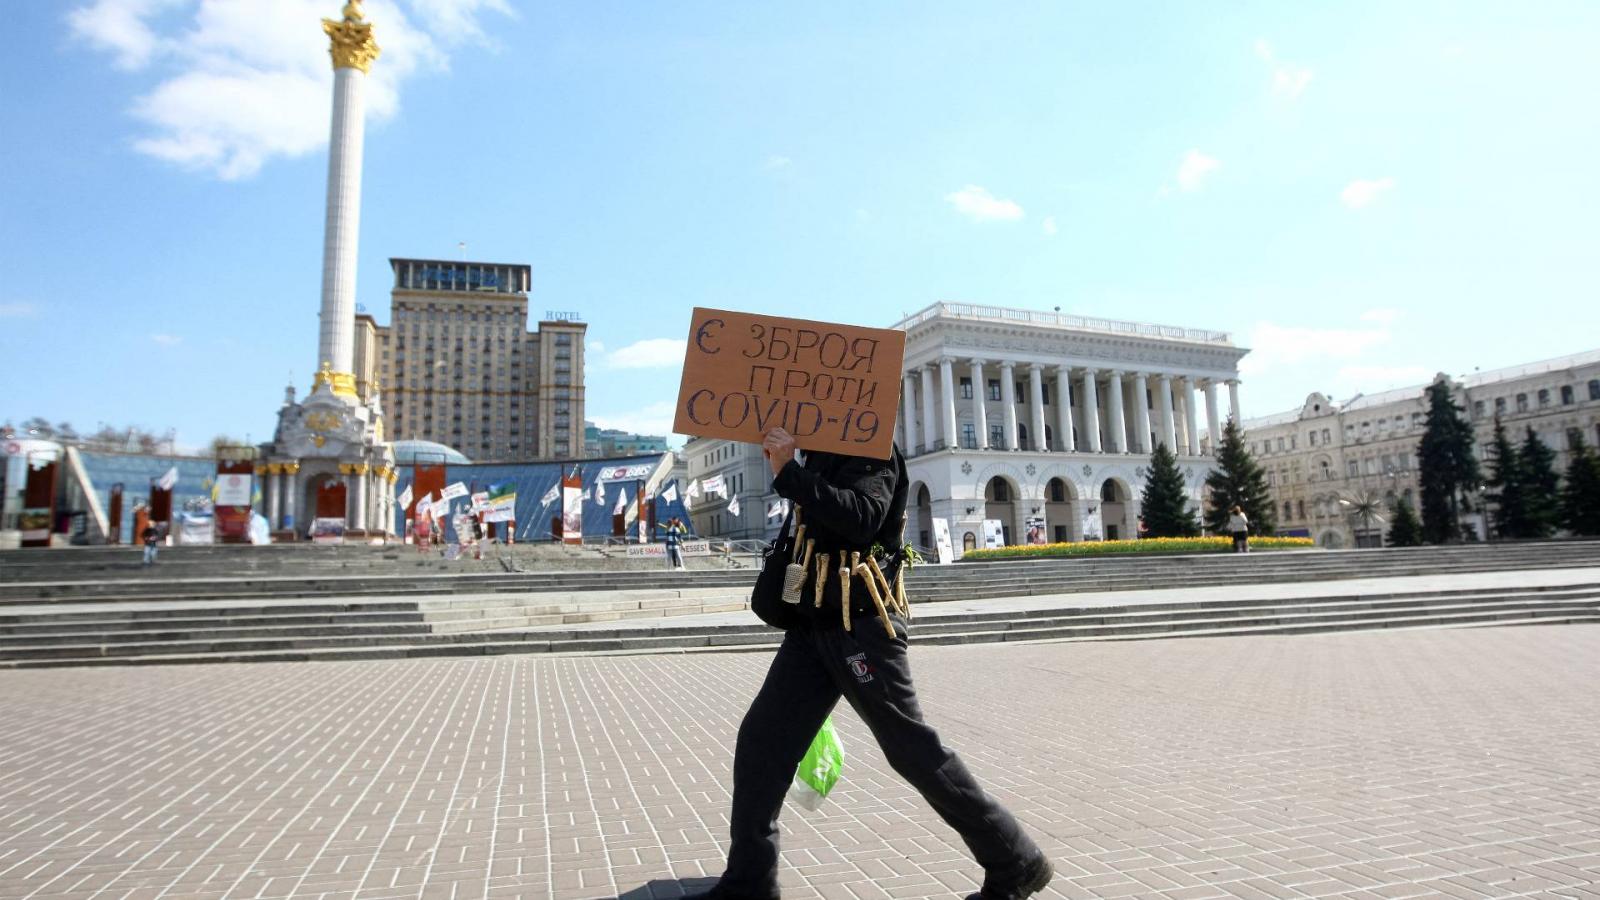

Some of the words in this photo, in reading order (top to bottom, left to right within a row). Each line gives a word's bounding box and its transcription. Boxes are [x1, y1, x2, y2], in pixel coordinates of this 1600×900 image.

[545, 310, 582, 320] HOTEL
[695, 318, 725, 354] Є
[742, 323, 881, 374] ЗБРОЯ
[748, 365, 879, 408] ПРОТИ
[686, 388, 880, 443] COVID-19
[629, 547, 644, 556] SAVE
[644, 545, 666, 555] SMALL
